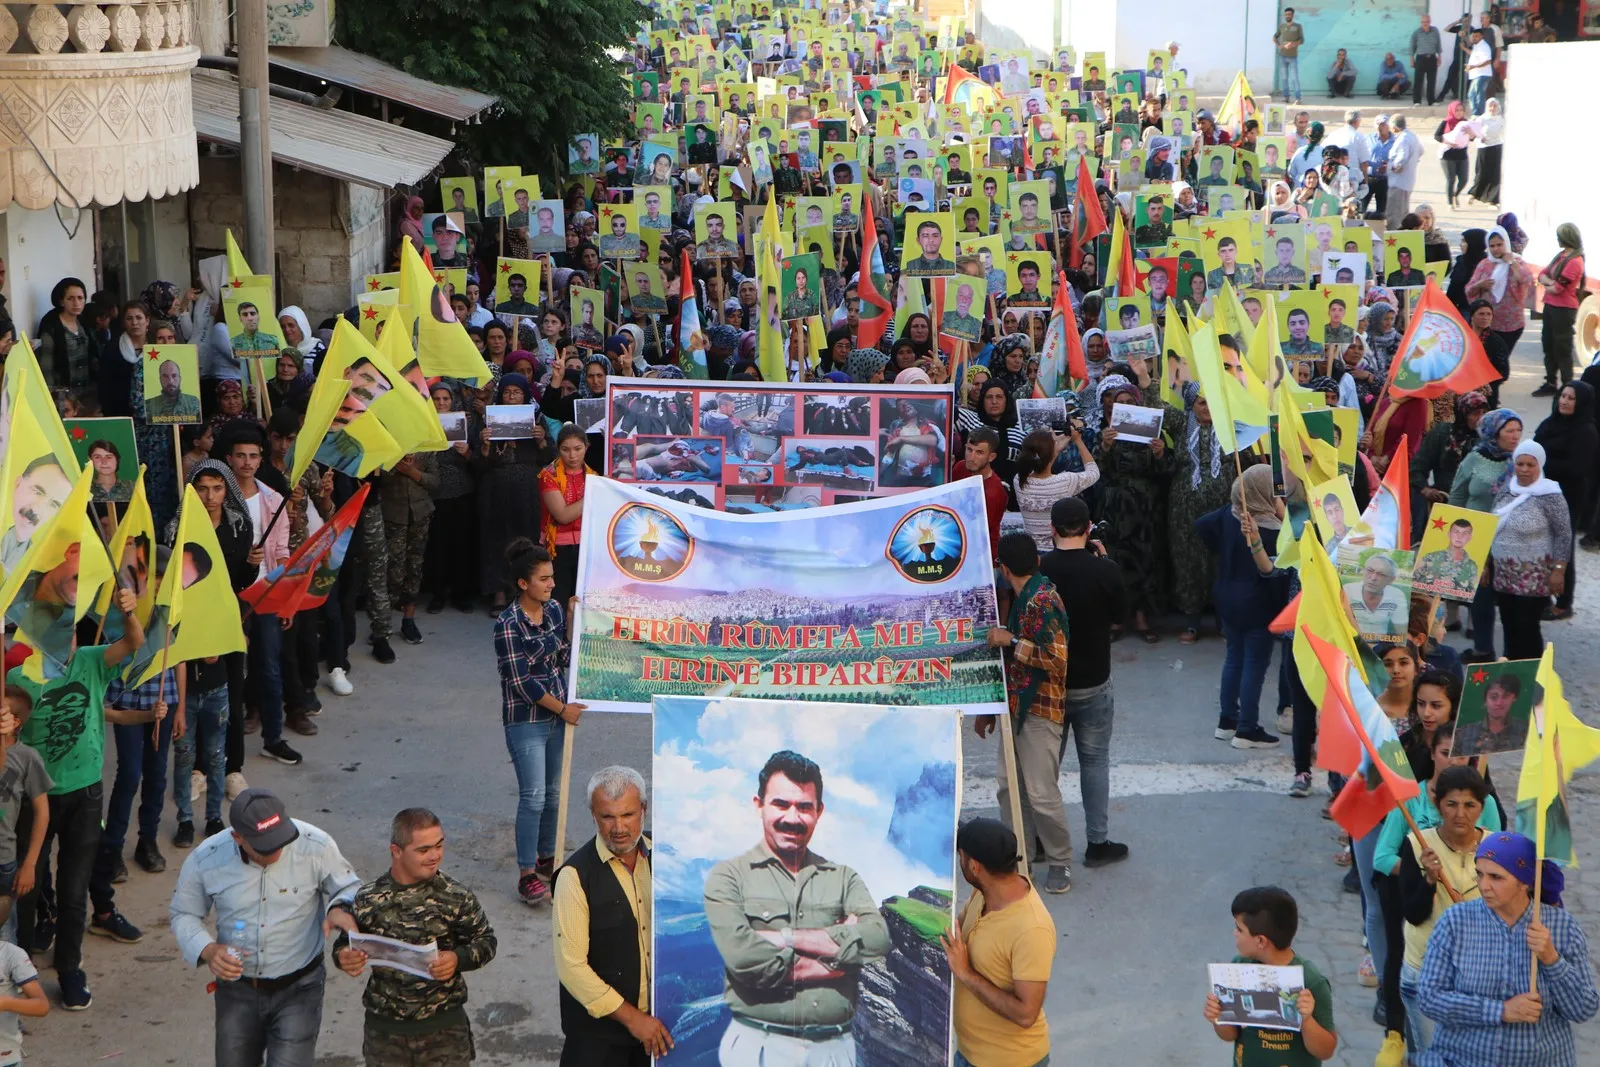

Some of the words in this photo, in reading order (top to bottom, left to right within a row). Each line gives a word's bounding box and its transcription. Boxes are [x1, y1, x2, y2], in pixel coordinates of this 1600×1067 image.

[610, 616, 711, 647] EFRÎN
[720, 619, 863, 650] RÛMETA
[872, 622, 923, 648] ME
[932, 618, 974, 645] YE
[641, 655, 761, 685] EFRÎNÊ
[771, 655, 953, 686] BIPARÊZIN
[1258, 1029, 1294, 1041] Beautiful
[1262, 1040, 1290, 1050] Dream
